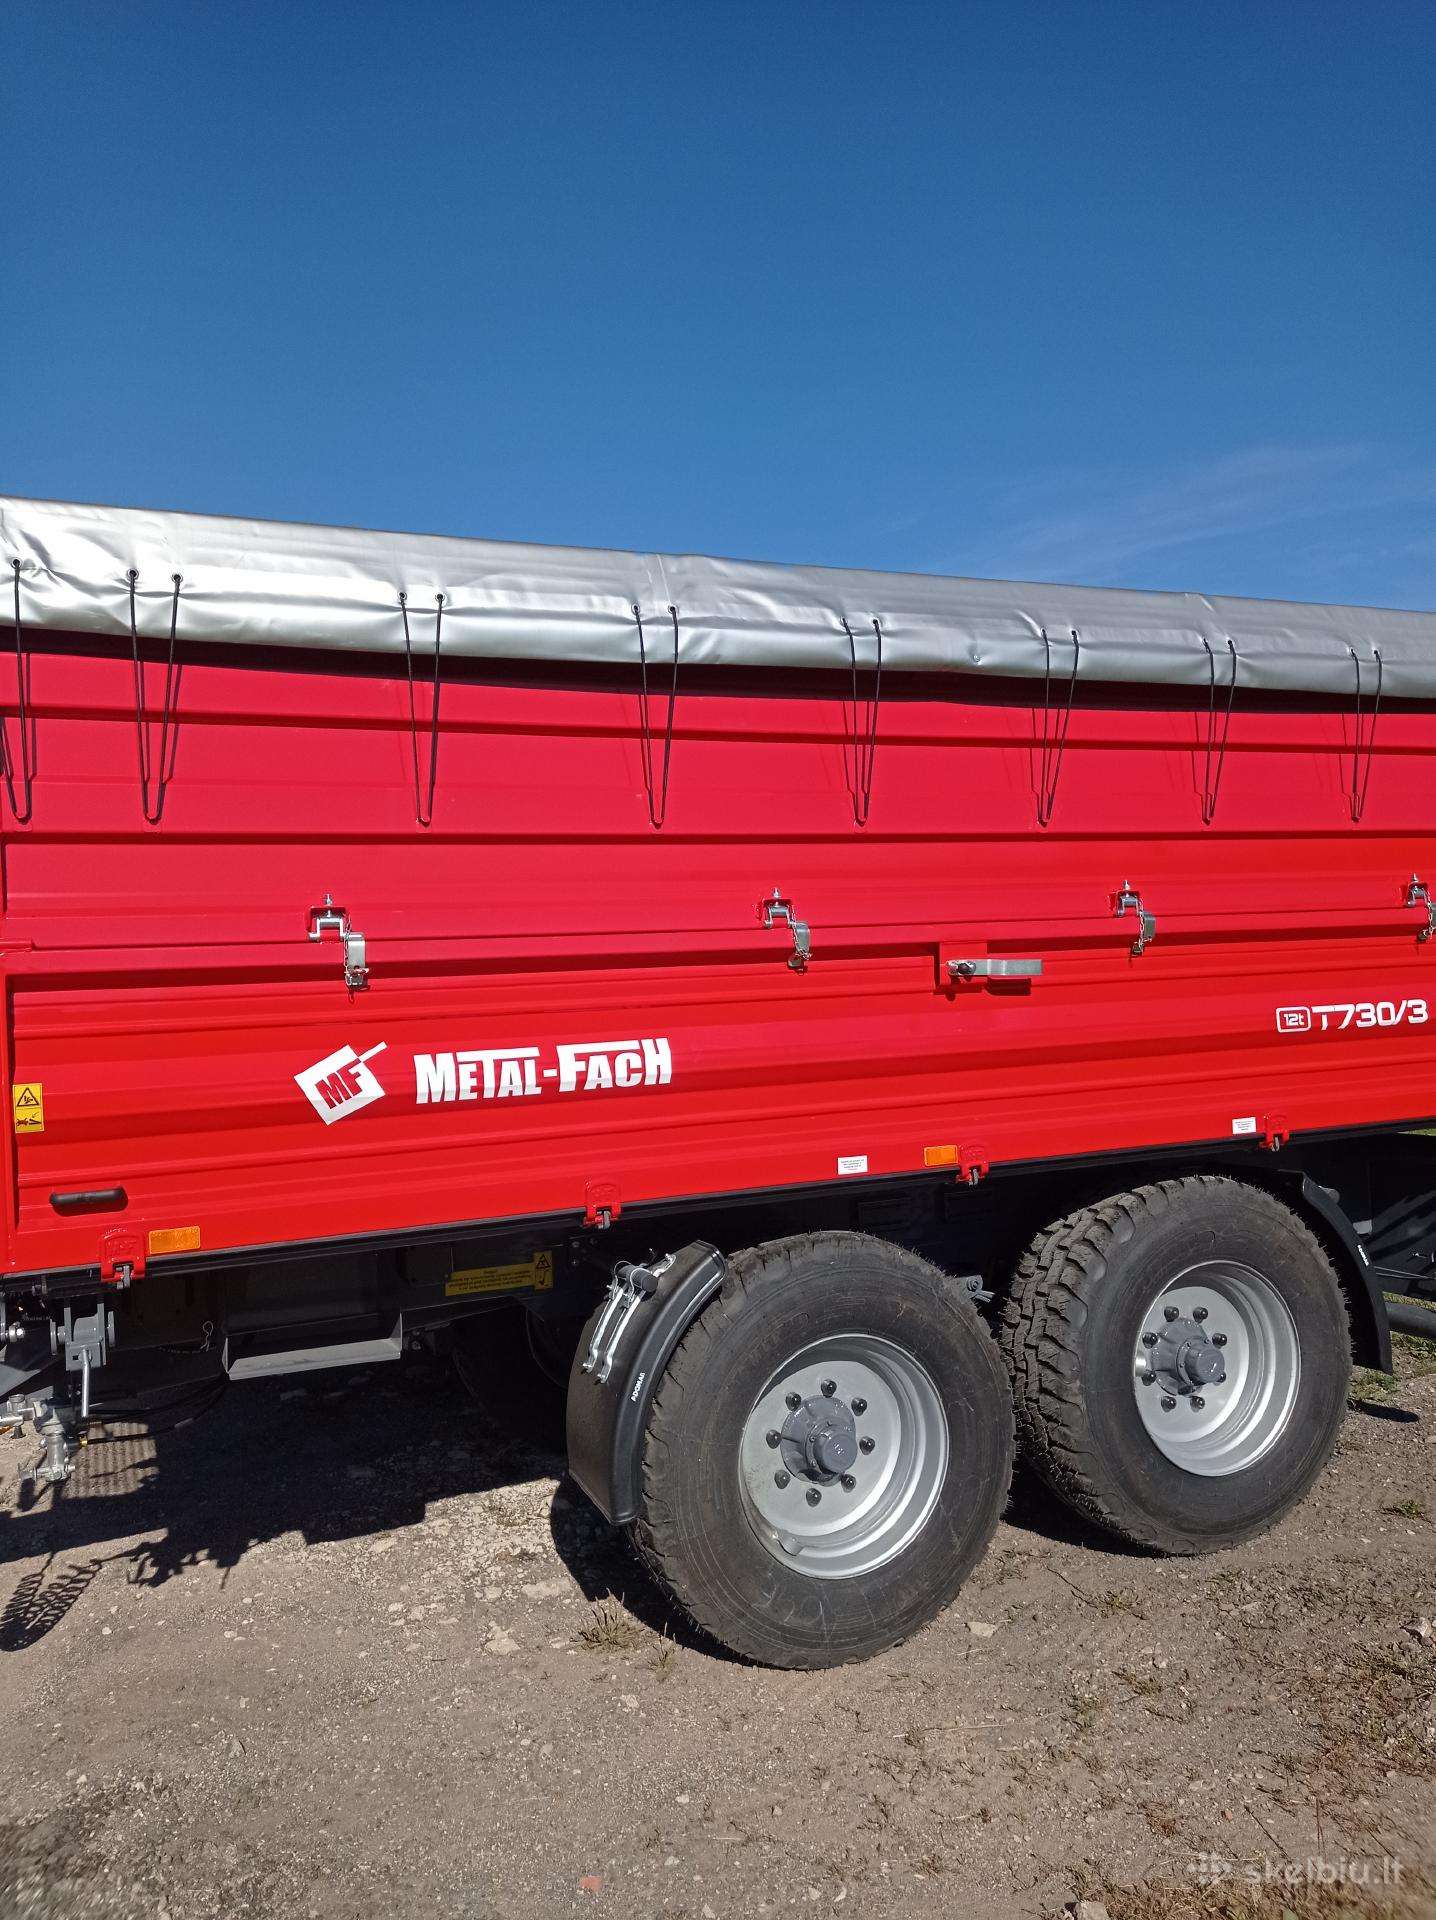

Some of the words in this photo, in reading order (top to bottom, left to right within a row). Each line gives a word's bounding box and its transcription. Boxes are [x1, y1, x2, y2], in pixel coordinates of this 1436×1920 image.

[1283, 1013, 1305, 1027] 12t
[1311, 999, 1429, 1031] T730/3
[314, 1058, 363, 1110] MF
[413, 1037, 672, 1105] METAL-FACH
